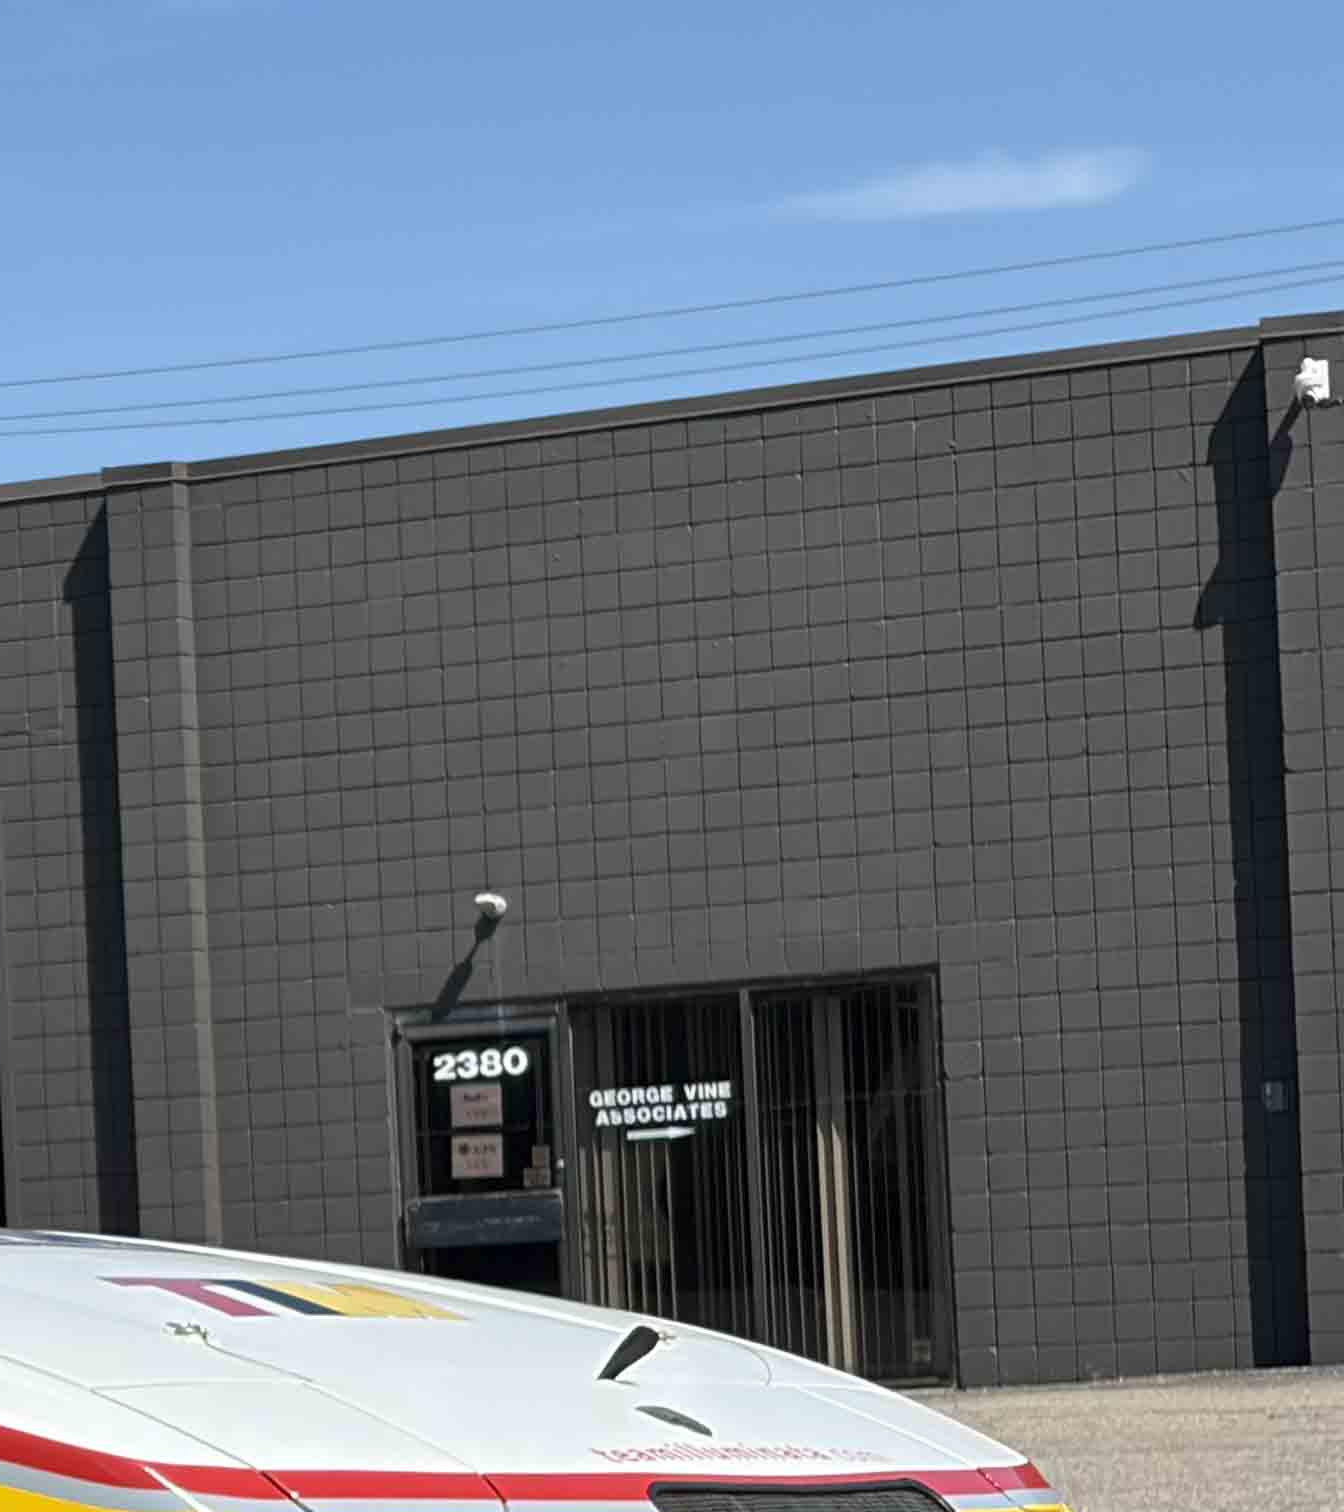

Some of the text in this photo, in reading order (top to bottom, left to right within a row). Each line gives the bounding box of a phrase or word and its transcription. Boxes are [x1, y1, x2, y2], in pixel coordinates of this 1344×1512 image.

[432, 1046, 528, 1080] 2380
[589, 1081, 732, 1108] GEORGE VINE
[595, 1101, 728, 1127] ASSOCIATES
